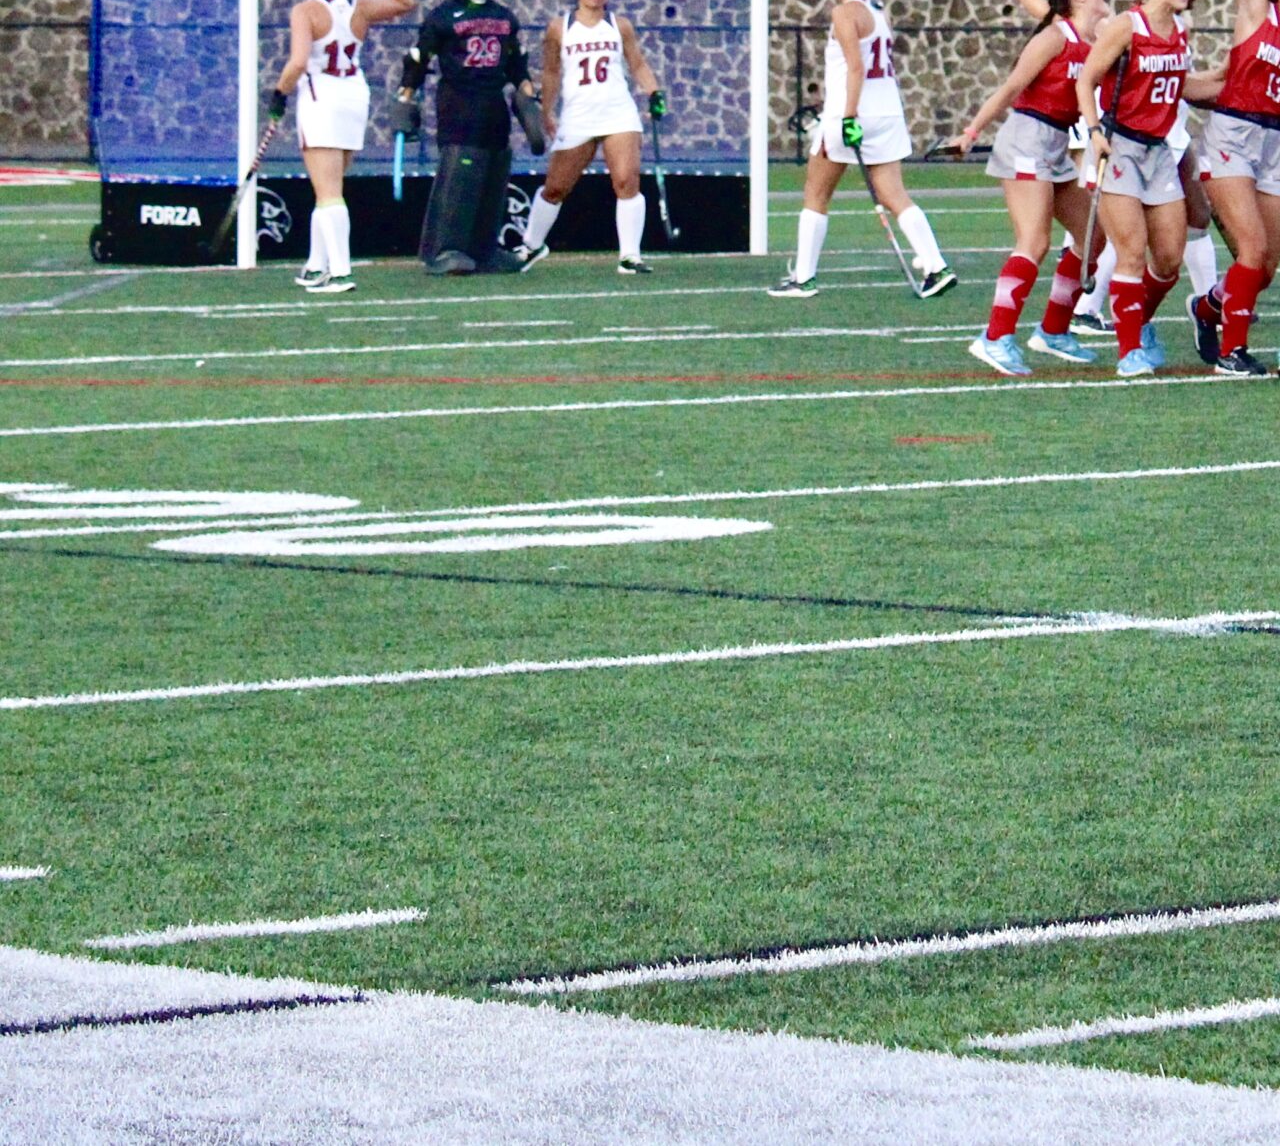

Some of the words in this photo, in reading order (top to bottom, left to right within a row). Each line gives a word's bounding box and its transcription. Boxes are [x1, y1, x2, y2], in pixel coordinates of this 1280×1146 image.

[463, 35, 502, 68] 29
[578, 56, 610, 86] 16
[1150, 76, 1180, 104] 20
[140, 204, 202, 227] FORZA
